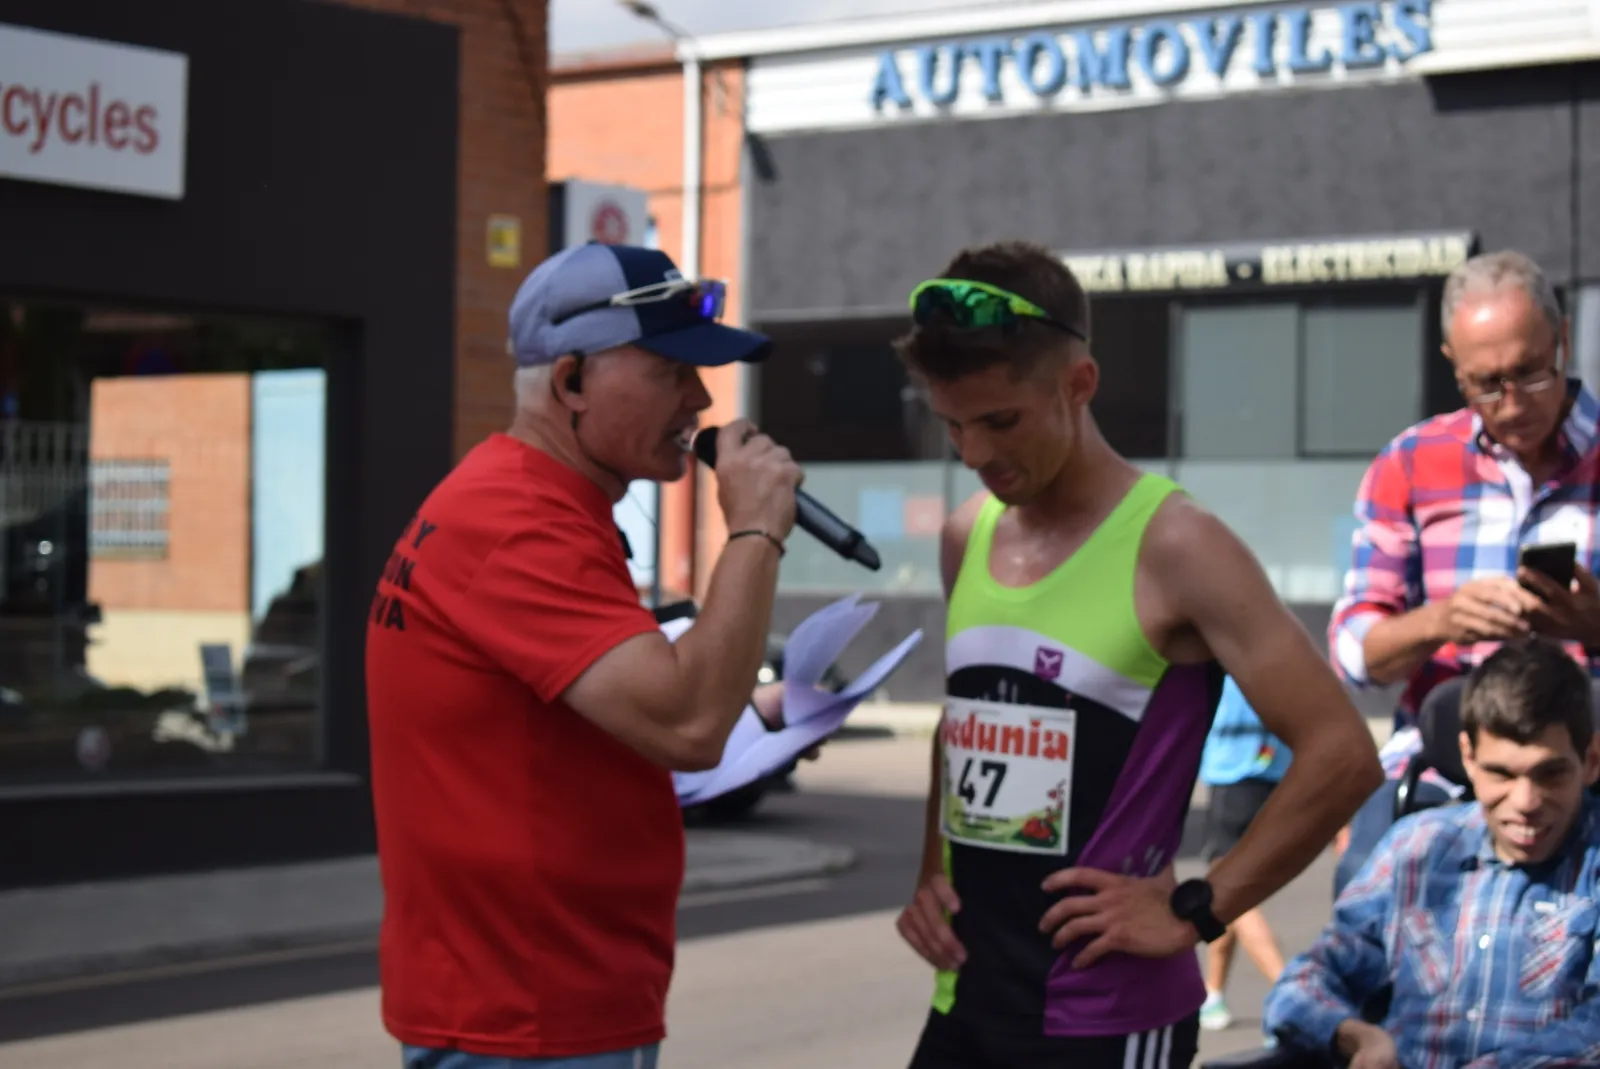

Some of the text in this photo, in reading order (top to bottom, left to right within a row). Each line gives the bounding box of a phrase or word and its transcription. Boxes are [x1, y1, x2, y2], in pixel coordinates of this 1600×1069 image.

[868, 0, 1434, 111] AUTOMOVILES
[0, 79, 160, 155] cycles
[958, 757, 1007, 808] 47
